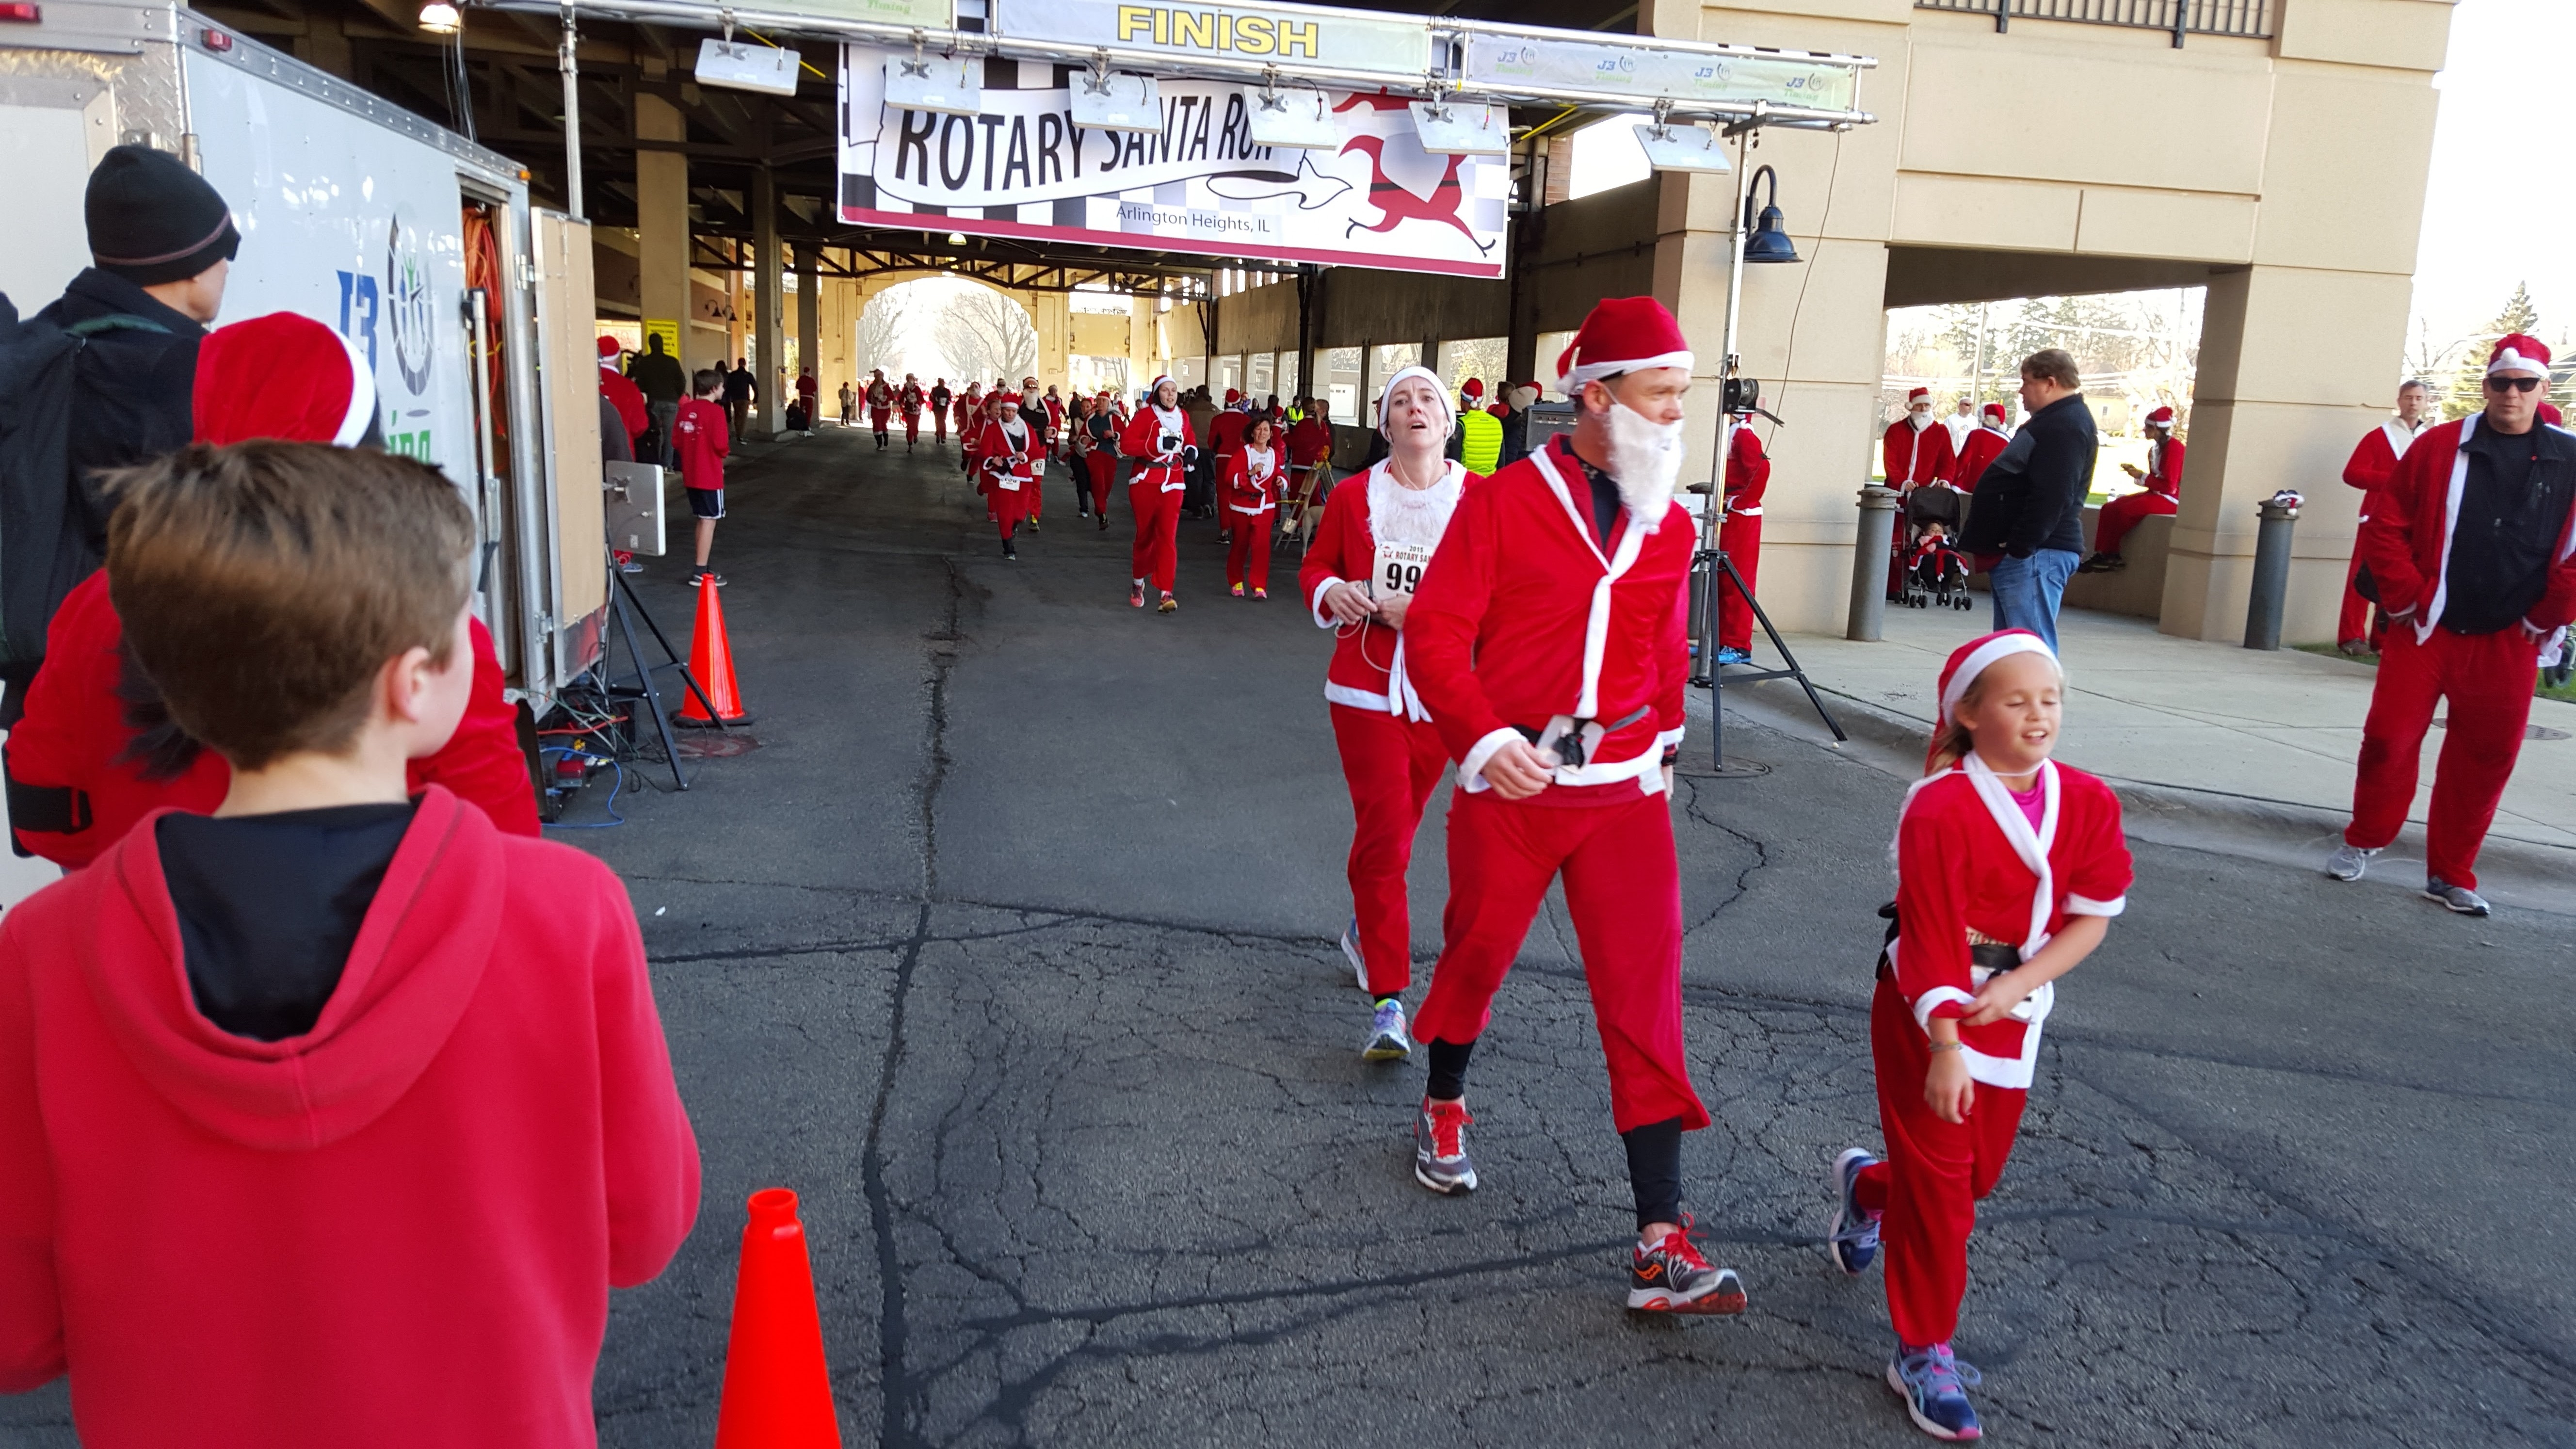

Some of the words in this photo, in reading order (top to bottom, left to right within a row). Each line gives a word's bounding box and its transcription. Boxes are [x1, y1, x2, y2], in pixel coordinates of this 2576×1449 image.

[1117, 4, 1319, 58] FINISH
[1695, 67, 1713, 78] J3
[1787, 77, 1805, 88] J3
[895, 110, 1085, 191] ROTARY
[1217, 93, 1272, 161] RU
[1116, 205, 1187, 225] Arlington
[1192, 213, 1254, 233] Heights,
[1258, 219, 1270, 232] IL
[1395, 551, 1419, 562] ROTARY
